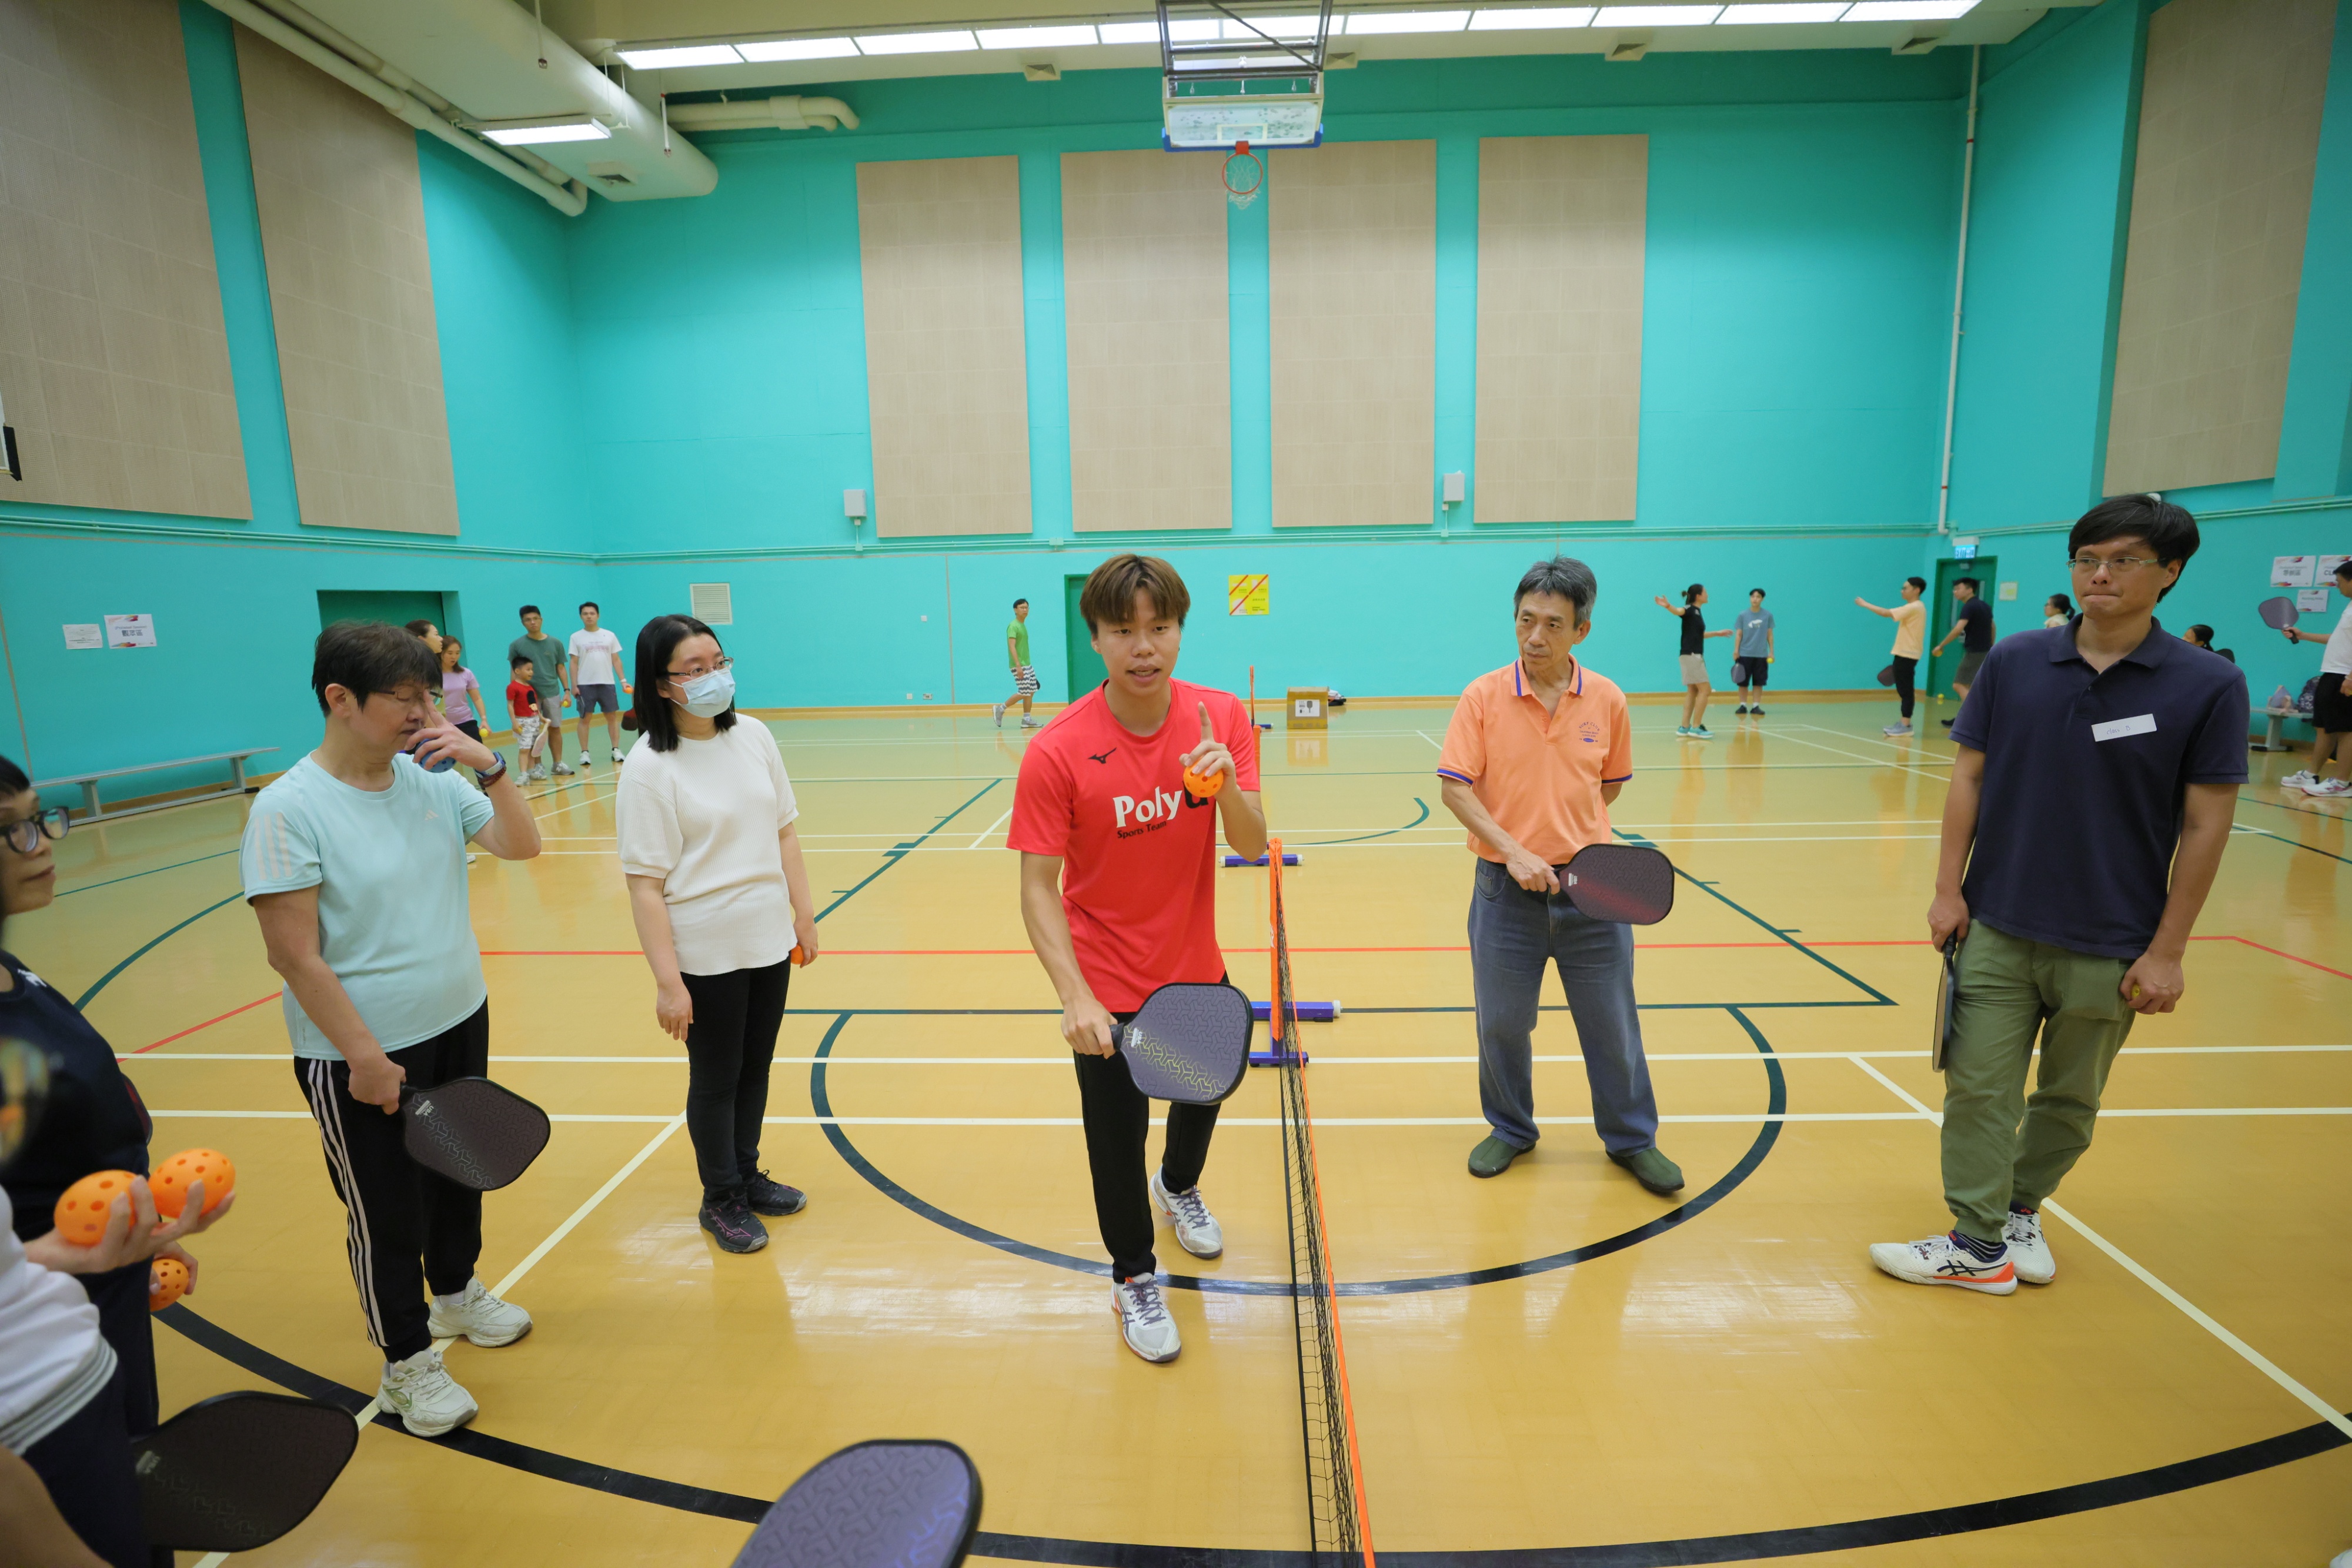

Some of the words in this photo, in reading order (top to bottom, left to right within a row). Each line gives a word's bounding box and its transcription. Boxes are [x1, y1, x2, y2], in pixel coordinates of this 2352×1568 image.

[1955, 547, 1966, 559] EXIT
[1590, 722, 1600, 732] CLUB
[1117, 828, 1144, 839] Sports
[1146, 821, 1167, 832] Team
[423, 1105, 434, 1116] USA
